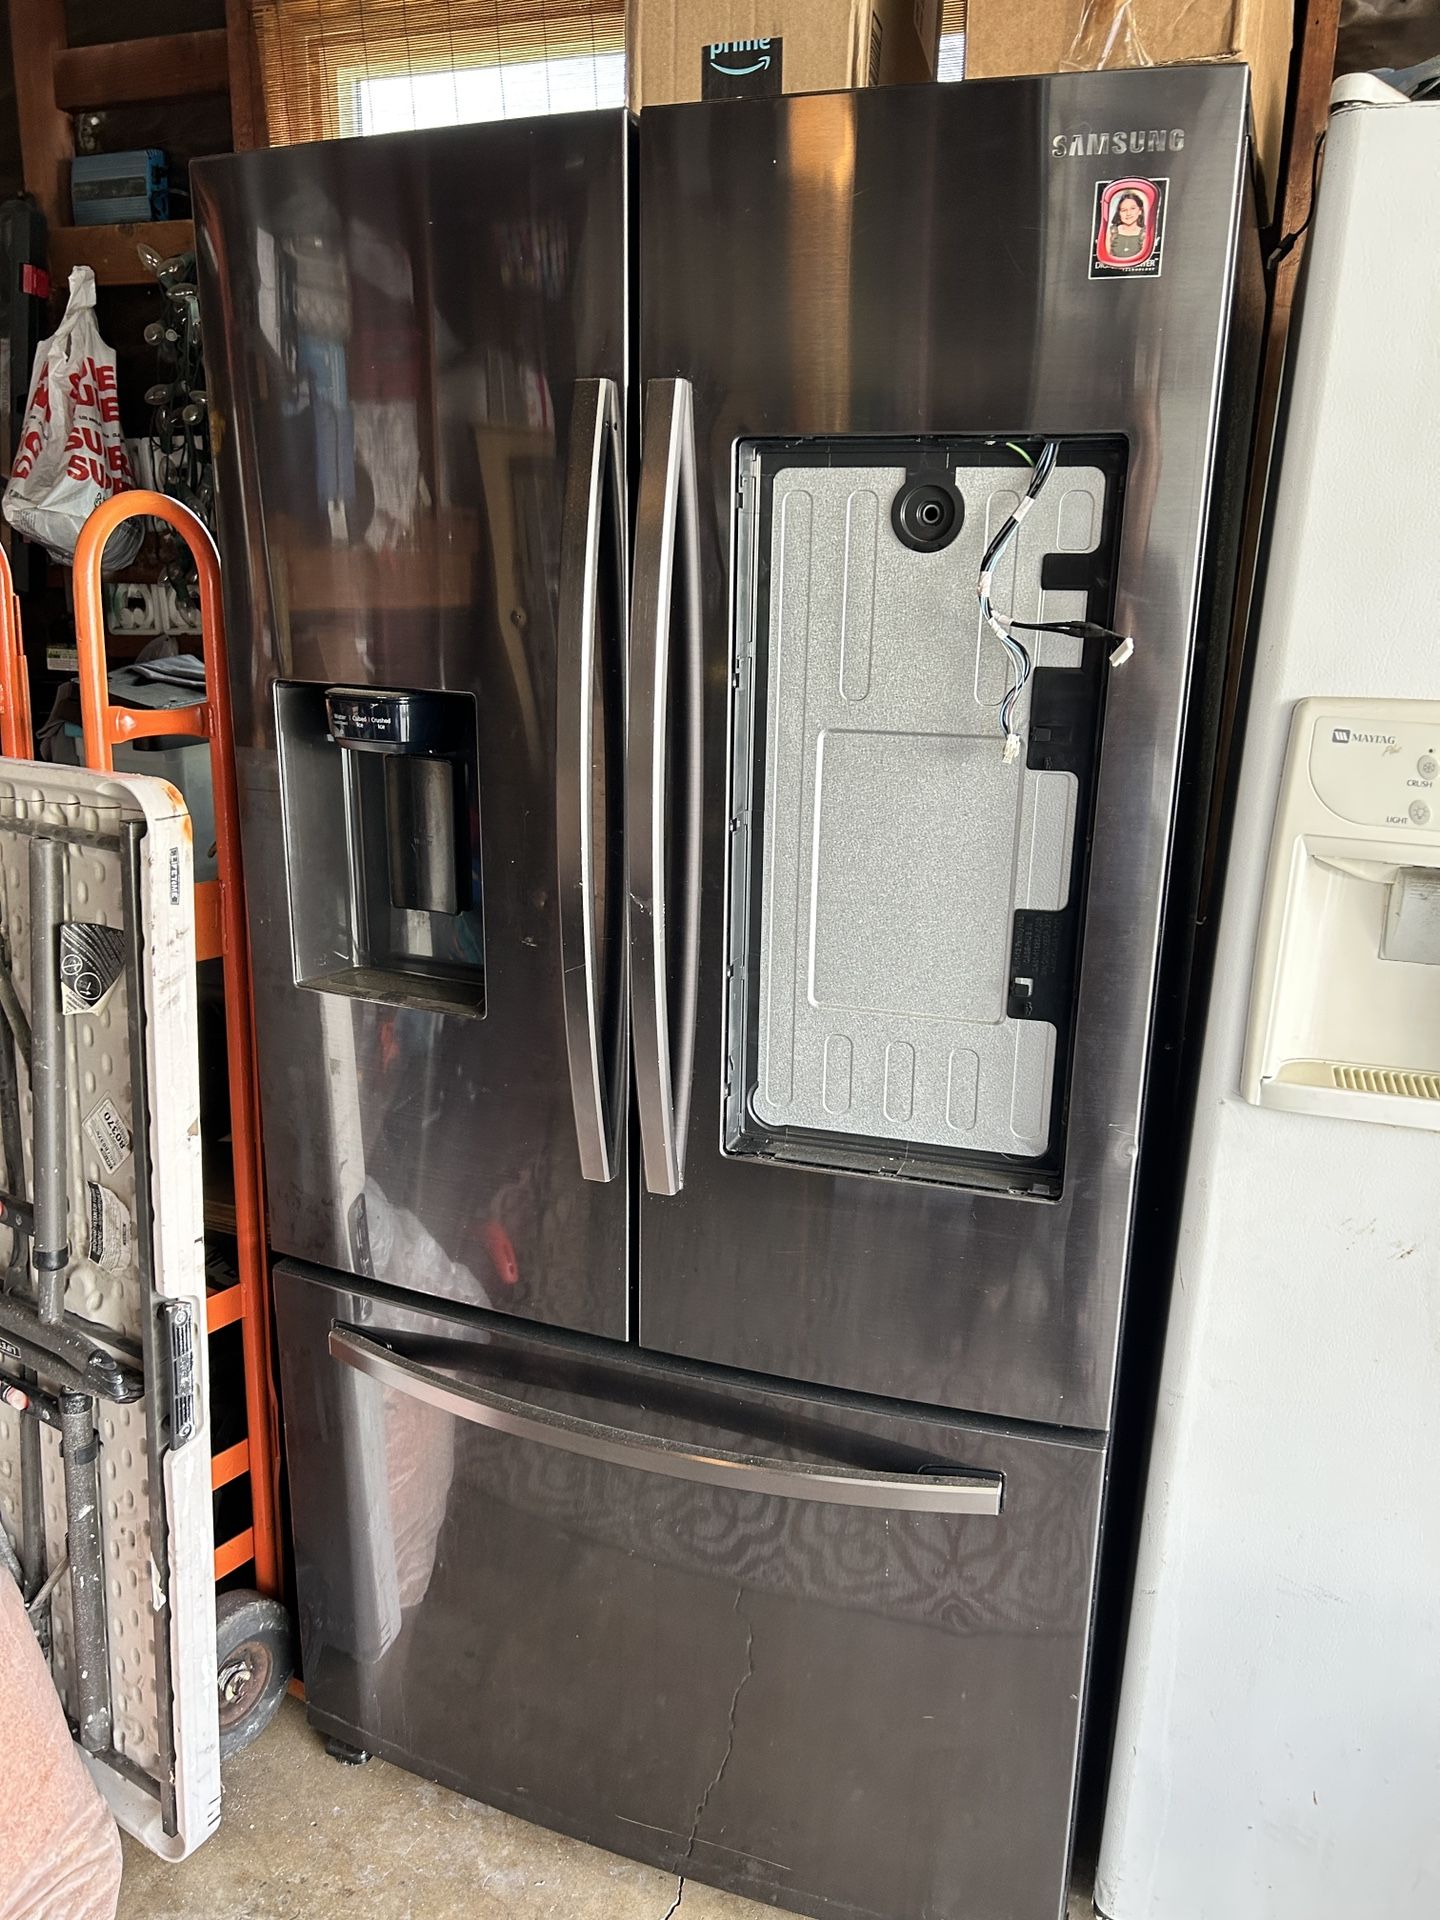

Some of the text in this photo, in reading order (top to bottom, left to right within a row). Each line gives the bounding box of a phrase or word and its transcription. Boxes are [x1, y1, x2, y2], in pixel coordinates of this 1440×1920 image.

[710, 38, 771, 60] prime
[1052, 128, 1185, 158] SAMSUNG
[352, 715, 367, 723] Cubed
[371, 716, 391, 724] Crushed
[1352, 733, 1396, 745] MAYTAG
[1406, 779, 1433, 788] CRUSH
[1385, 816, 1408, 825] LIGHT
